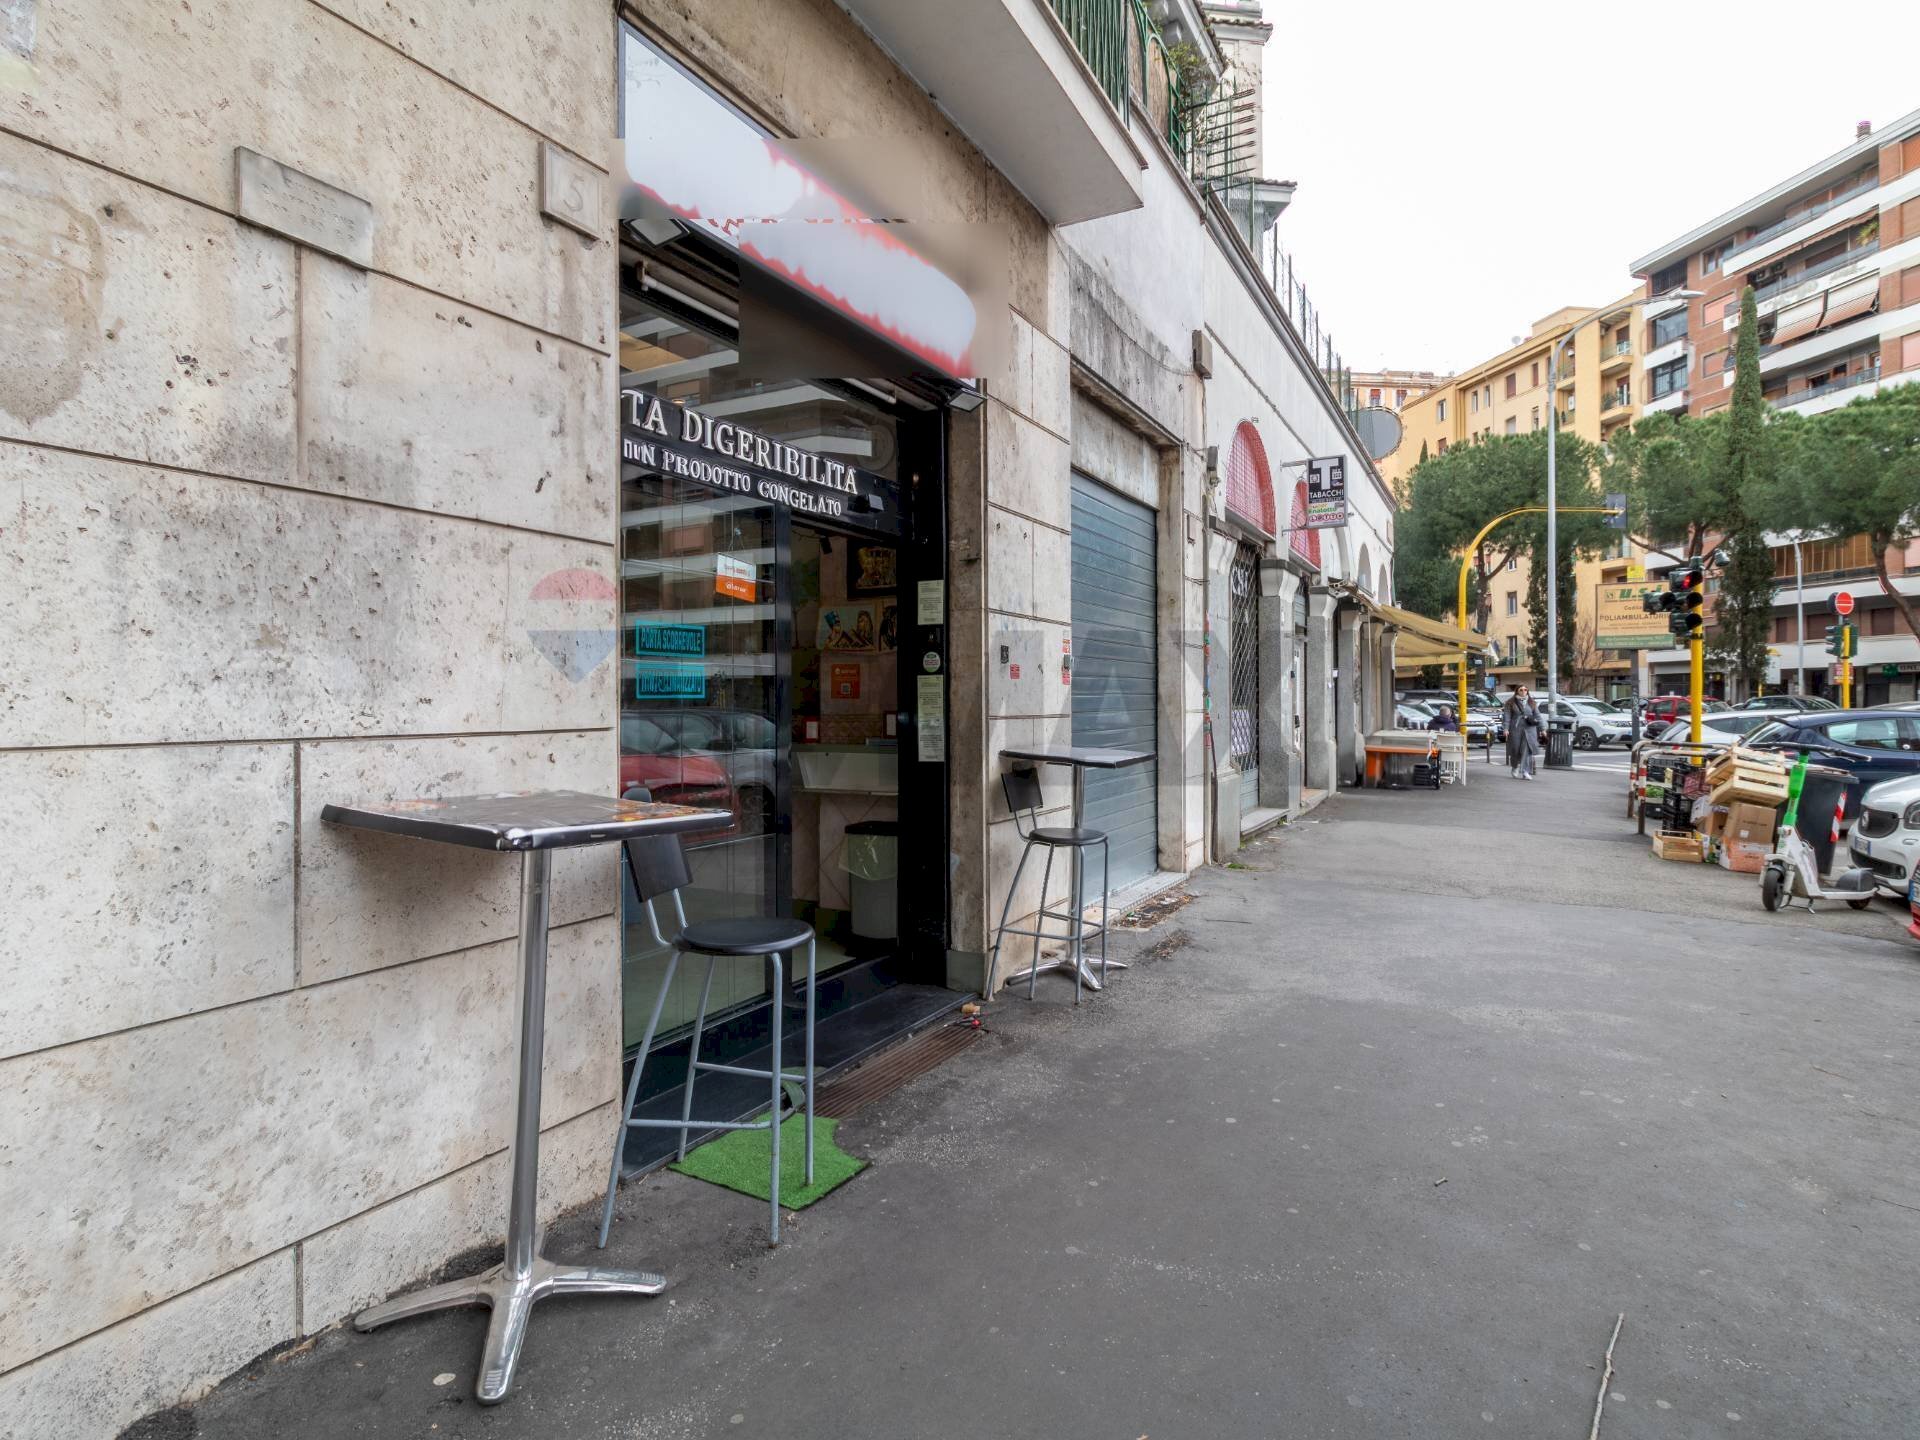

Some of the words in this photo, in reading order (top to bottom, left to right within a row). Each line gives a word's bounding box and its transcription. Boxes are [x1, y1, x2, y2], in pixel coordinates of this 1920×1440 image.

[661, 448, 751, 492] PRODOTTO
[757, 478, 842, 516] CONGELATO
[1312, 458, 1340, 490] T
[1309, 489, 1344, 499] TABACCHI
